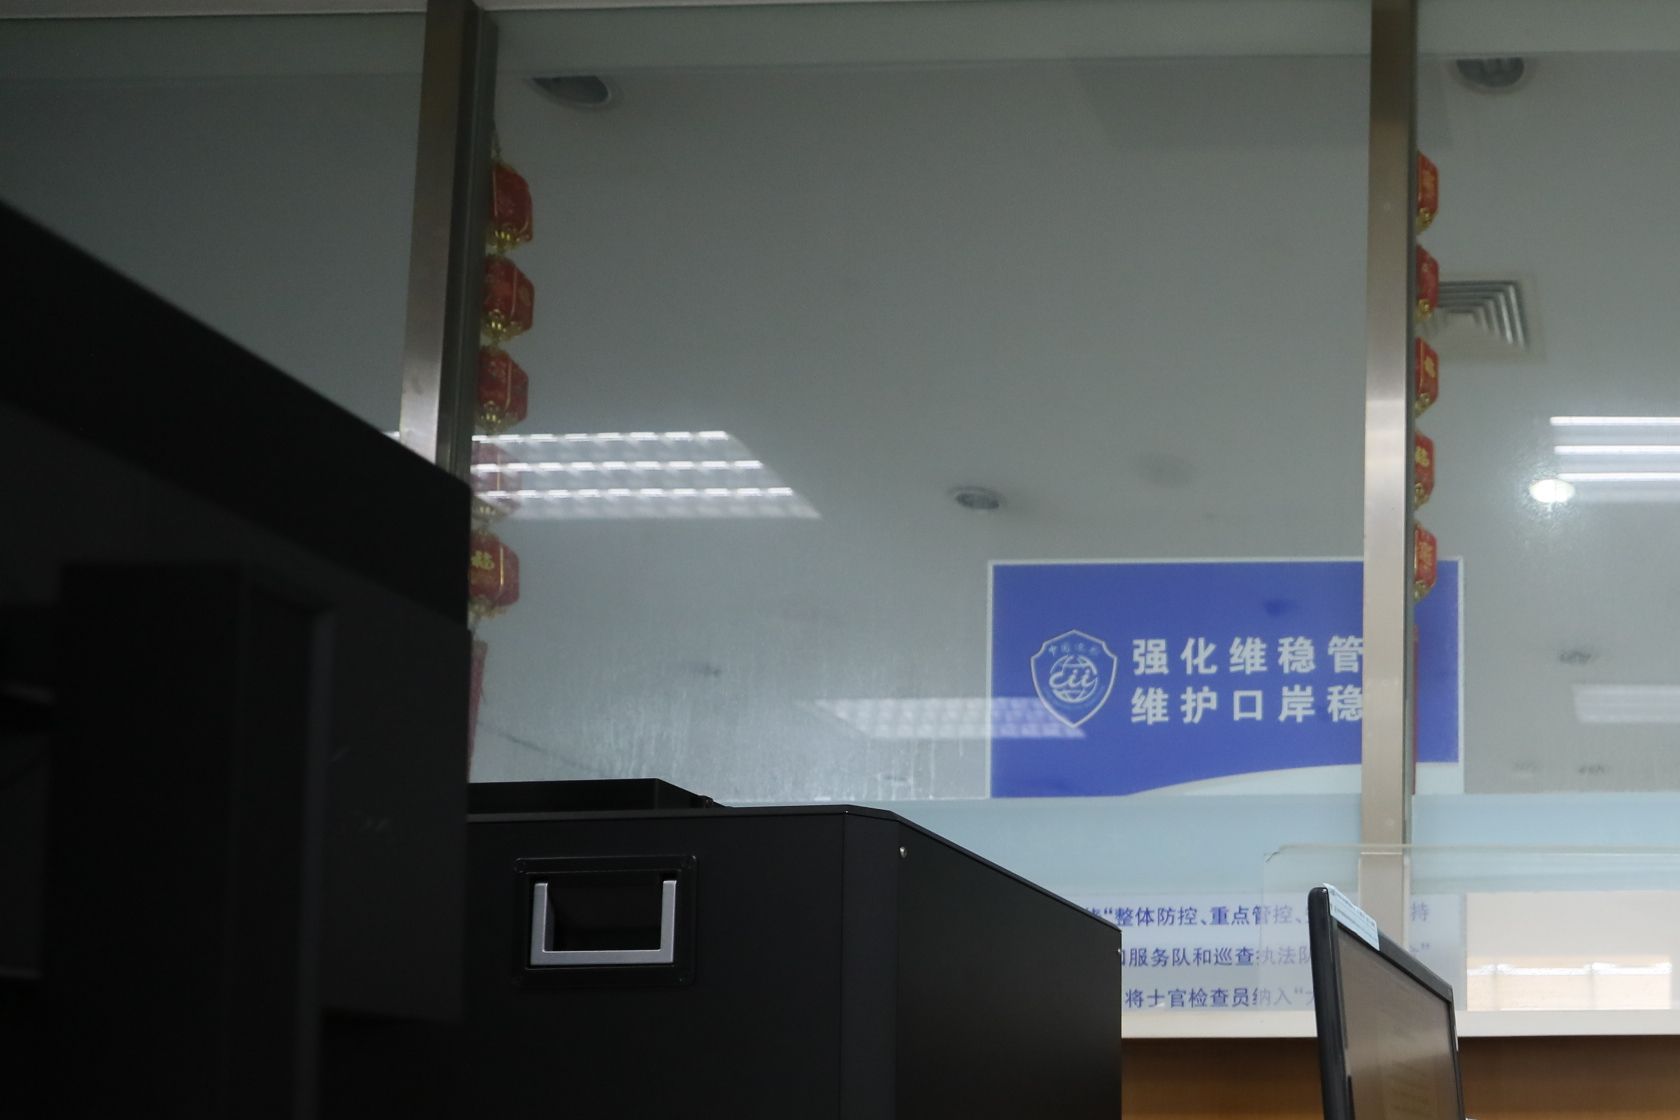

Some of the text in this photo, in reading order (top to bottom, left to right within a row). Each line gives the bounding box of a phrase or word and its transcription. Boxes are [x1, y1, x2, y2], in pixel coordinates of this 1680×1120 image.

[1133, 636, 1364, 675] 强化维稳管
[1130, 685, 1364, 726] 维护口岸稳
[1121, 946, 1311, 967] 服务队和巡查执法队
